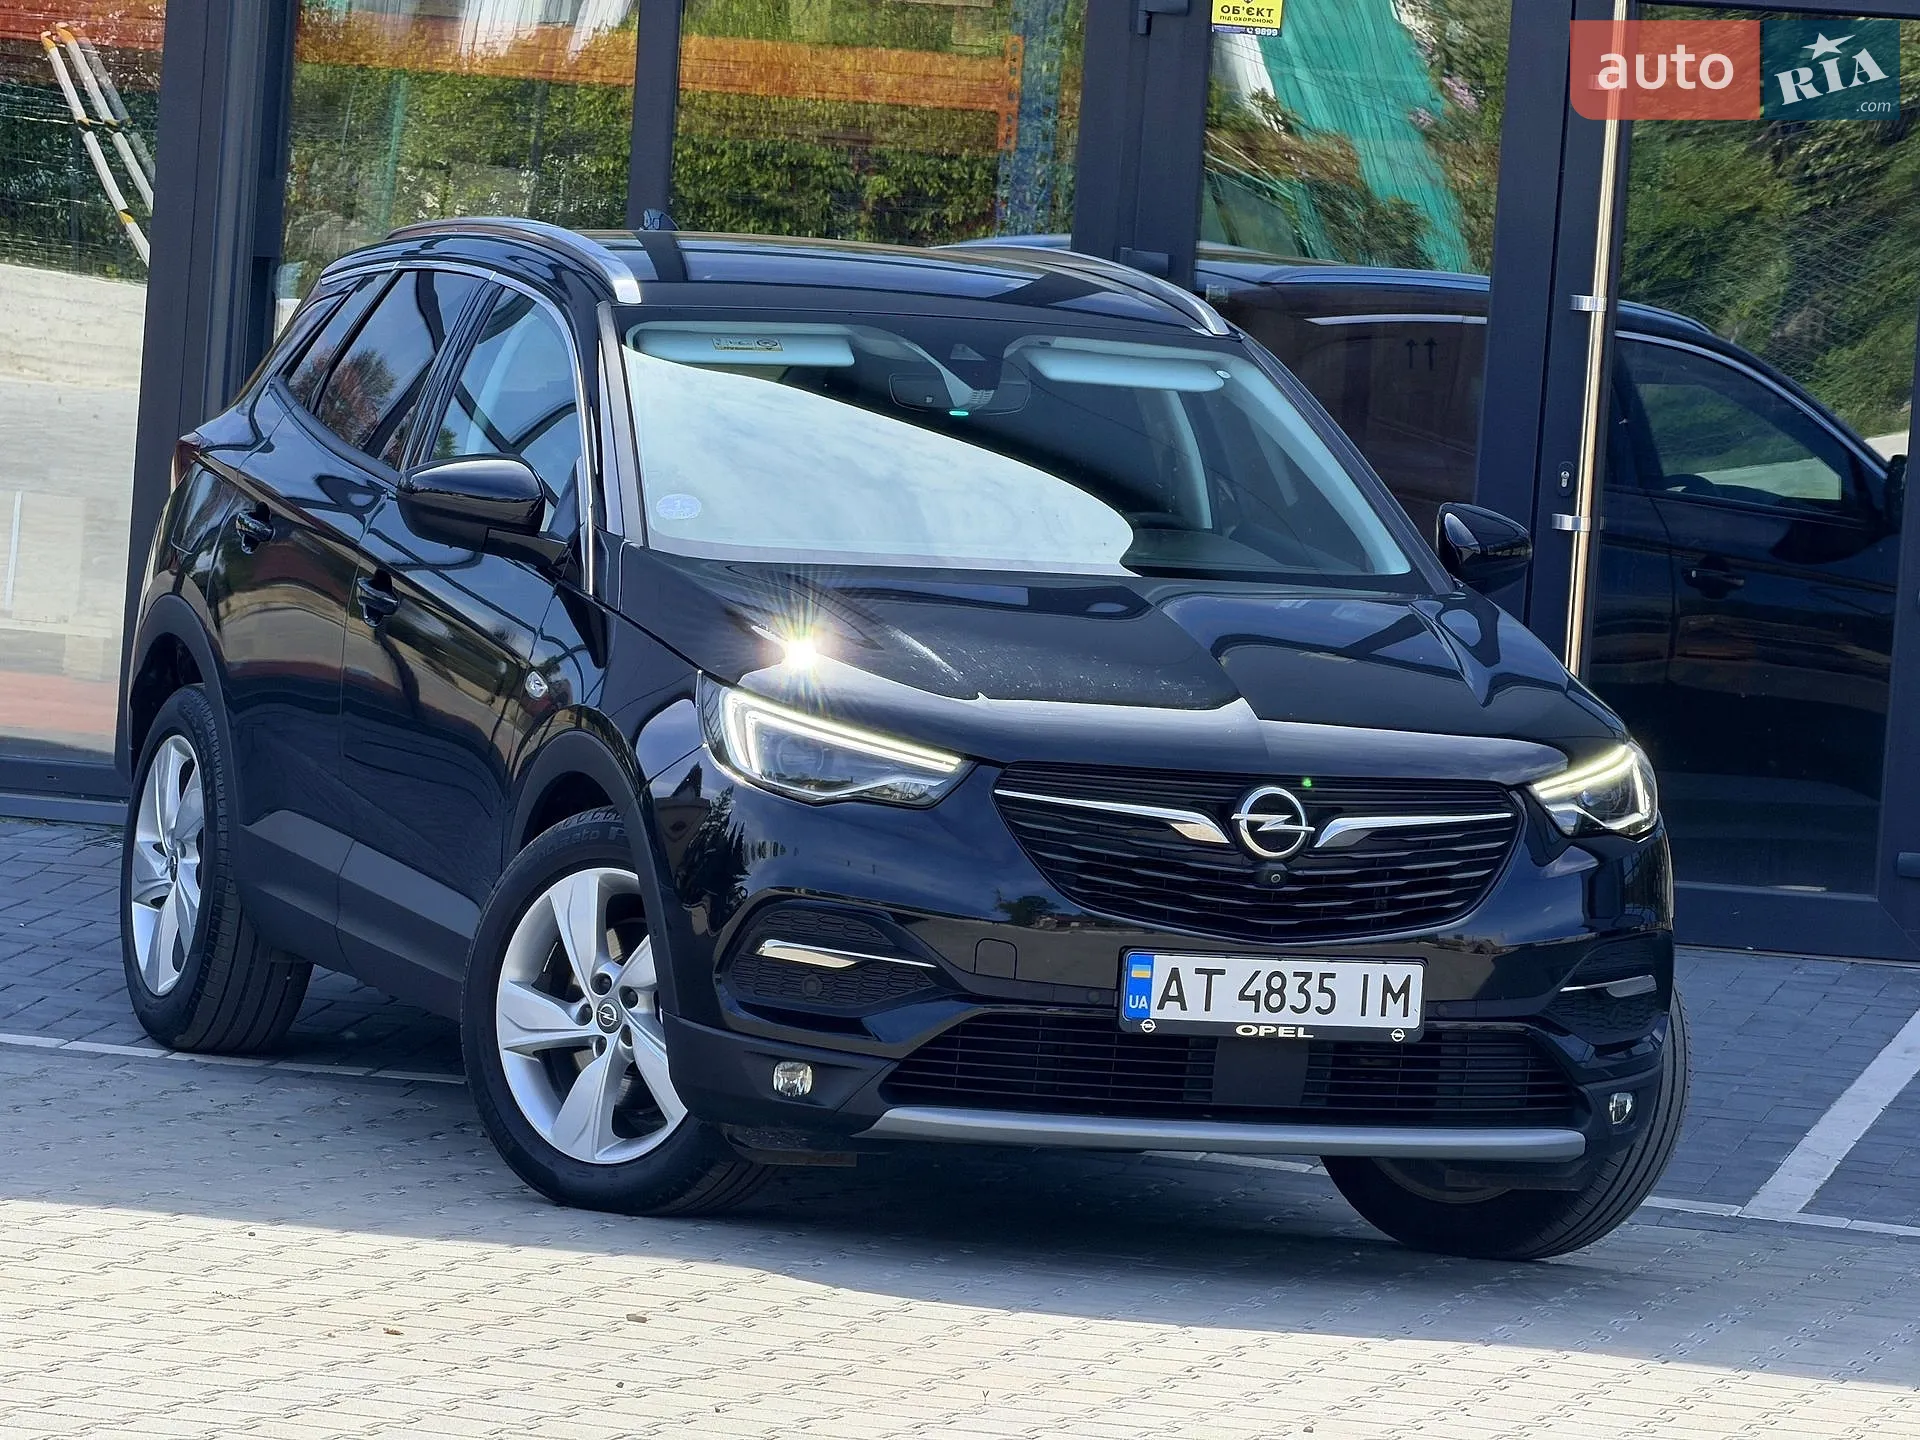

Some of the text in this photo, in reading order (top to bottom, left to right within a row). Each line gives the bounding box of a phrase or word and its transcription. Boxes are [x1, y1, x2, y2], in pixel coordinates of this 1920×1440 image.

[1220, 5, 1274, 18] ОБ'ЄКТ
[1156, 967, 1412, 1018] AT 4835 IM
[1129, 995, 1149, 1010] UA
[1235, 1024, 1314, 1038] OPEL
